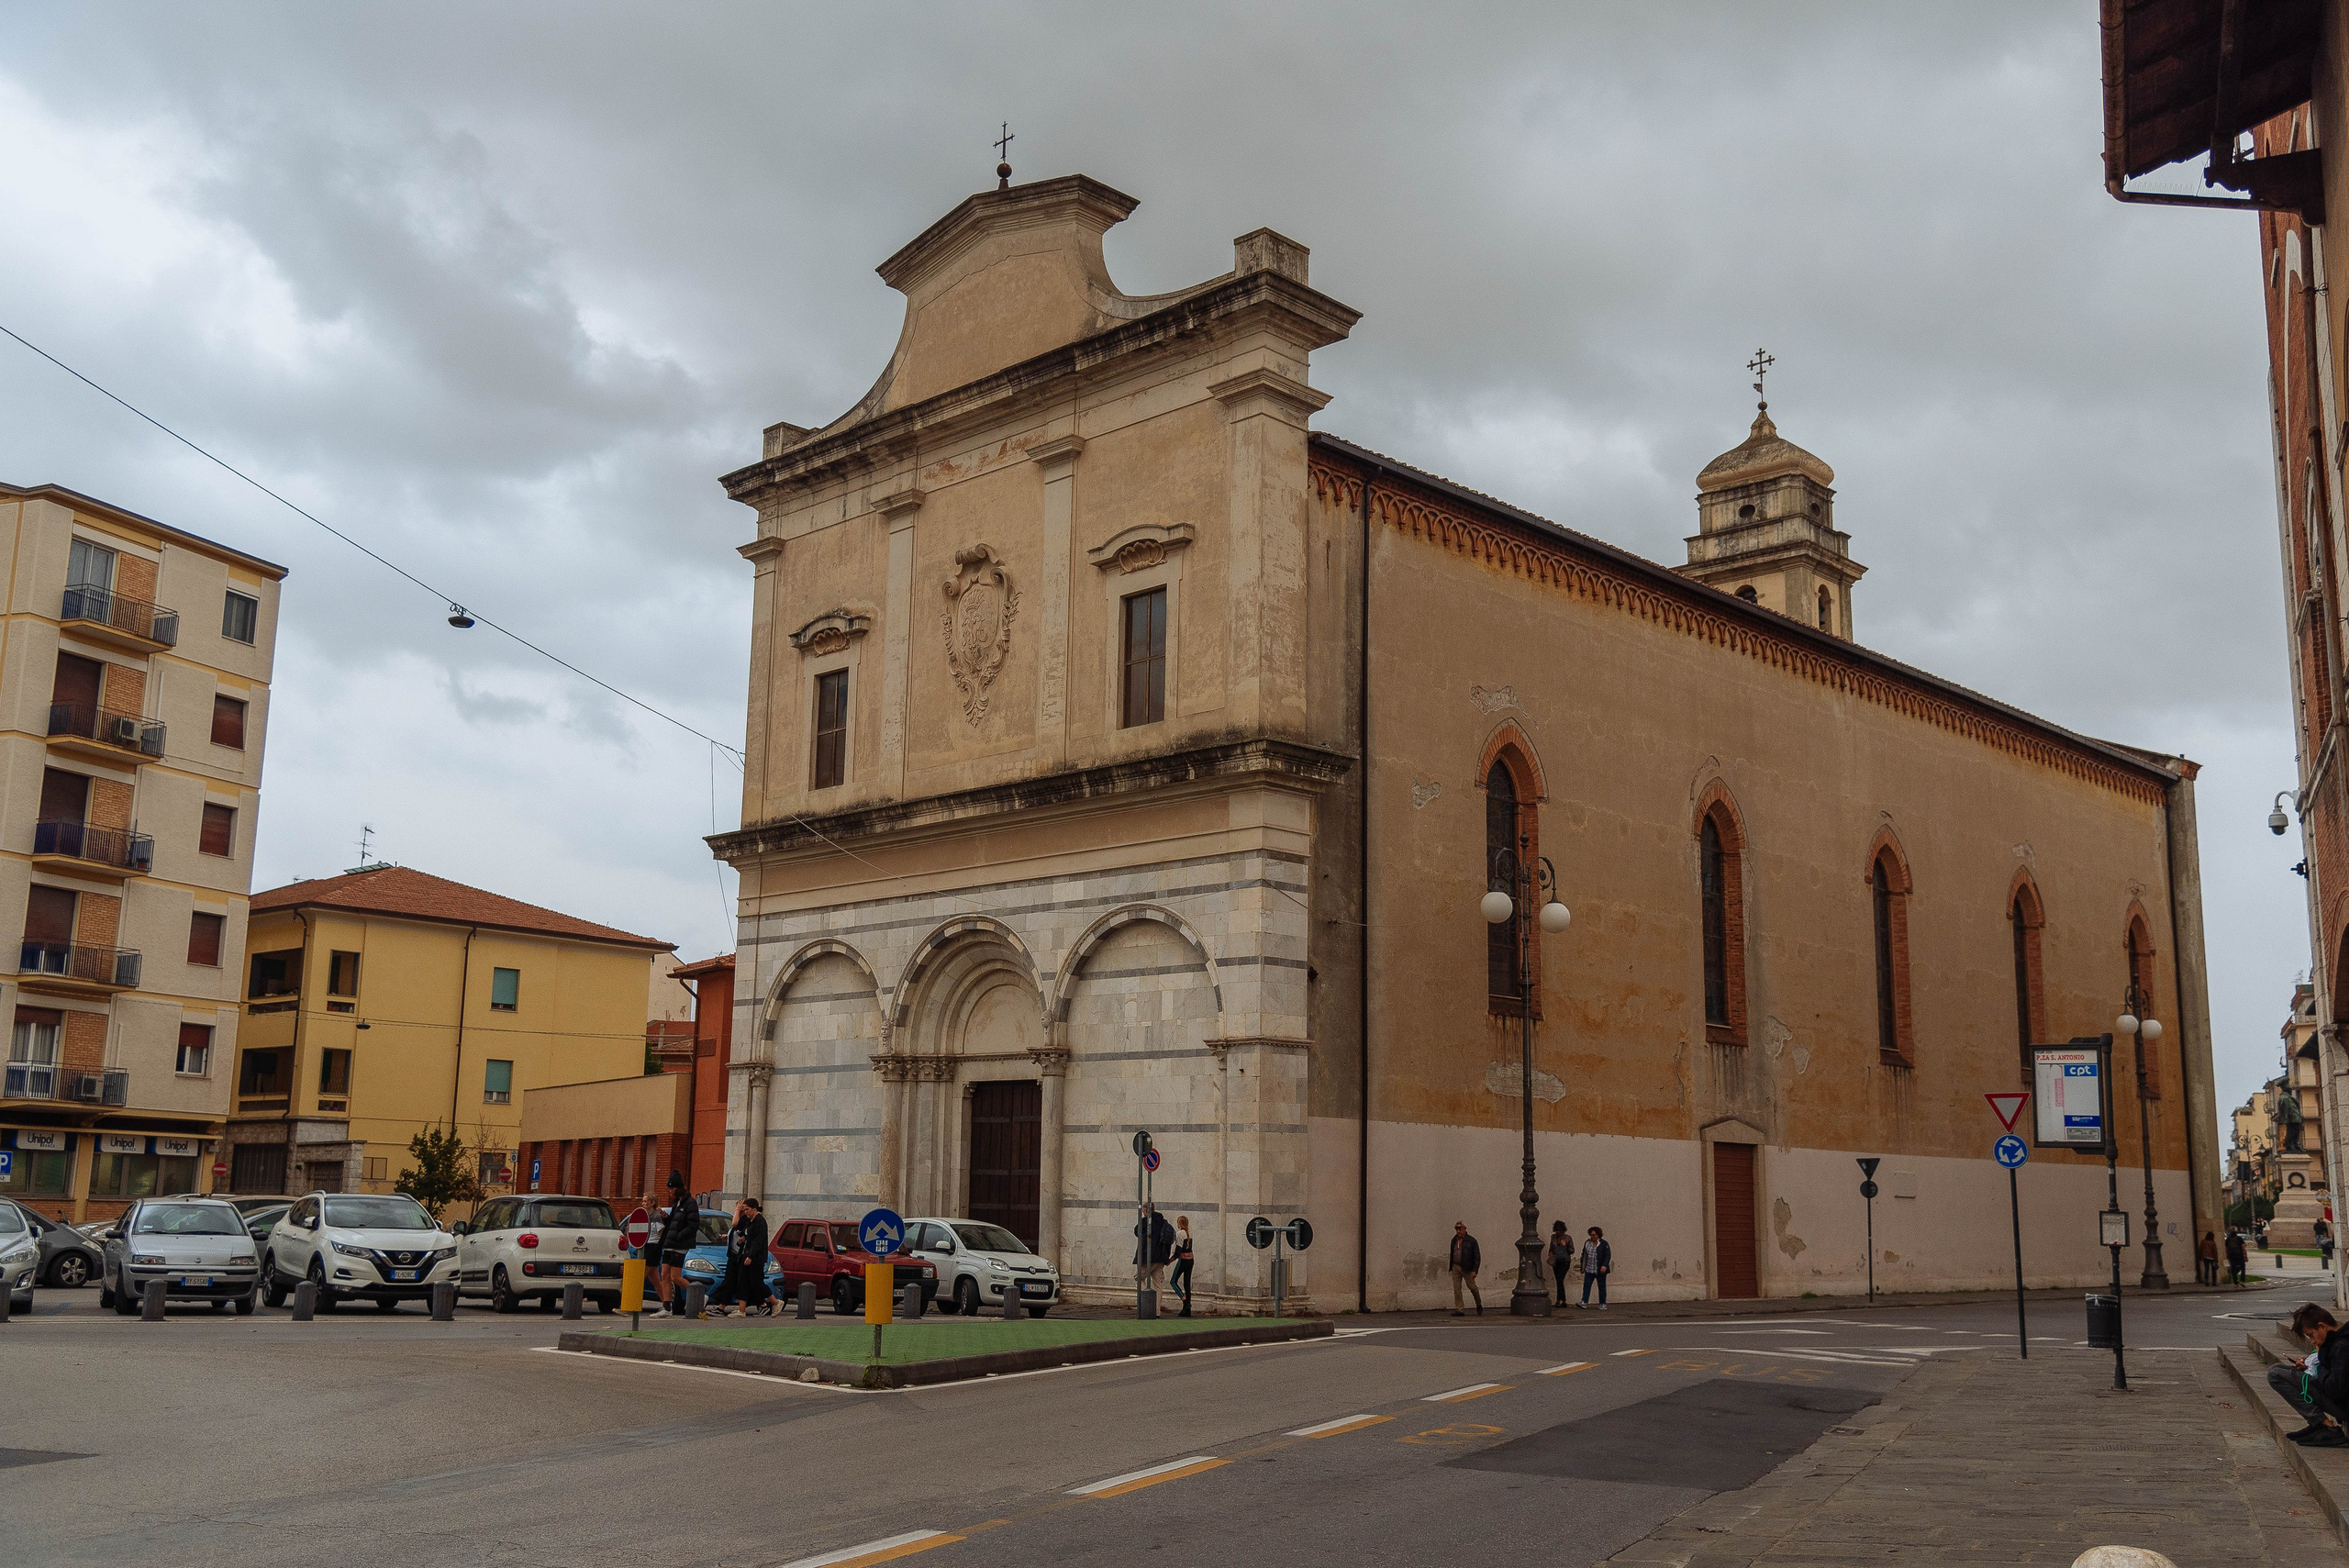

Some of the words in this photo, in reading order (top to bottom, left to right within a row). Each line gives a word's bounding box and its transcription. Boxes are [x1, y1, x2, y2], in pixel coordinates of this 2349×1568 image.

[2069, 1065, 2091, 1075] cpt
[28, 1132, 54, 1147] Unipol
[110, 1137, 135, 1151] Unipol
[164, 1140, 188, 1153] Unipol
[533, 1162, 540, 1179] P
[1655, 1359, 1834, 1383] BUS
